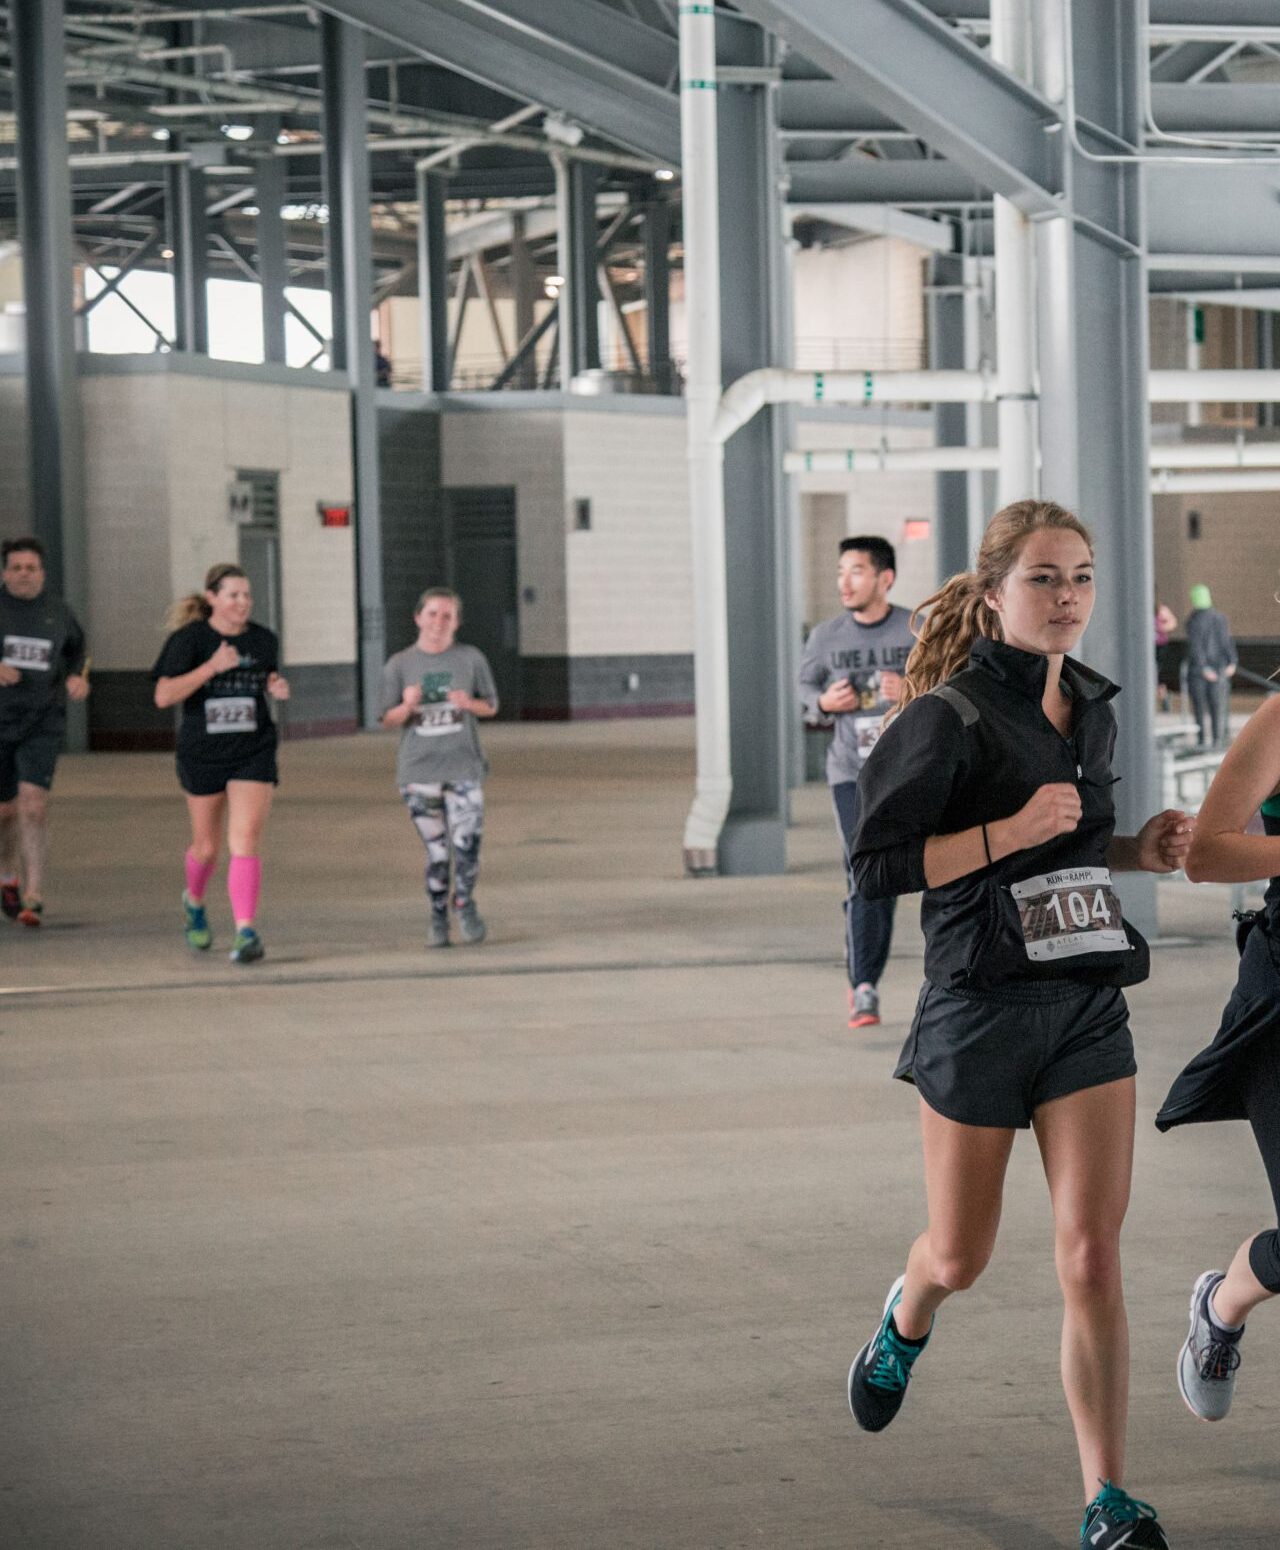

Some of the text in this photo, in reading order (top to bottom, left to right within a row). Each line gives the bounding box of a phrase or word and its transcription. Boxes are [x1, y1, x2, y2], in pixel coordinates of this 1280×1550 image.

[831, 649, 861, 669] LIVE
[868, 647, 878, 666] A
[1046, 875, 1063, 885] RUN
[1069, 871, 1093, 882] RAMPS
[1046, 888, 1111, 930] 104
